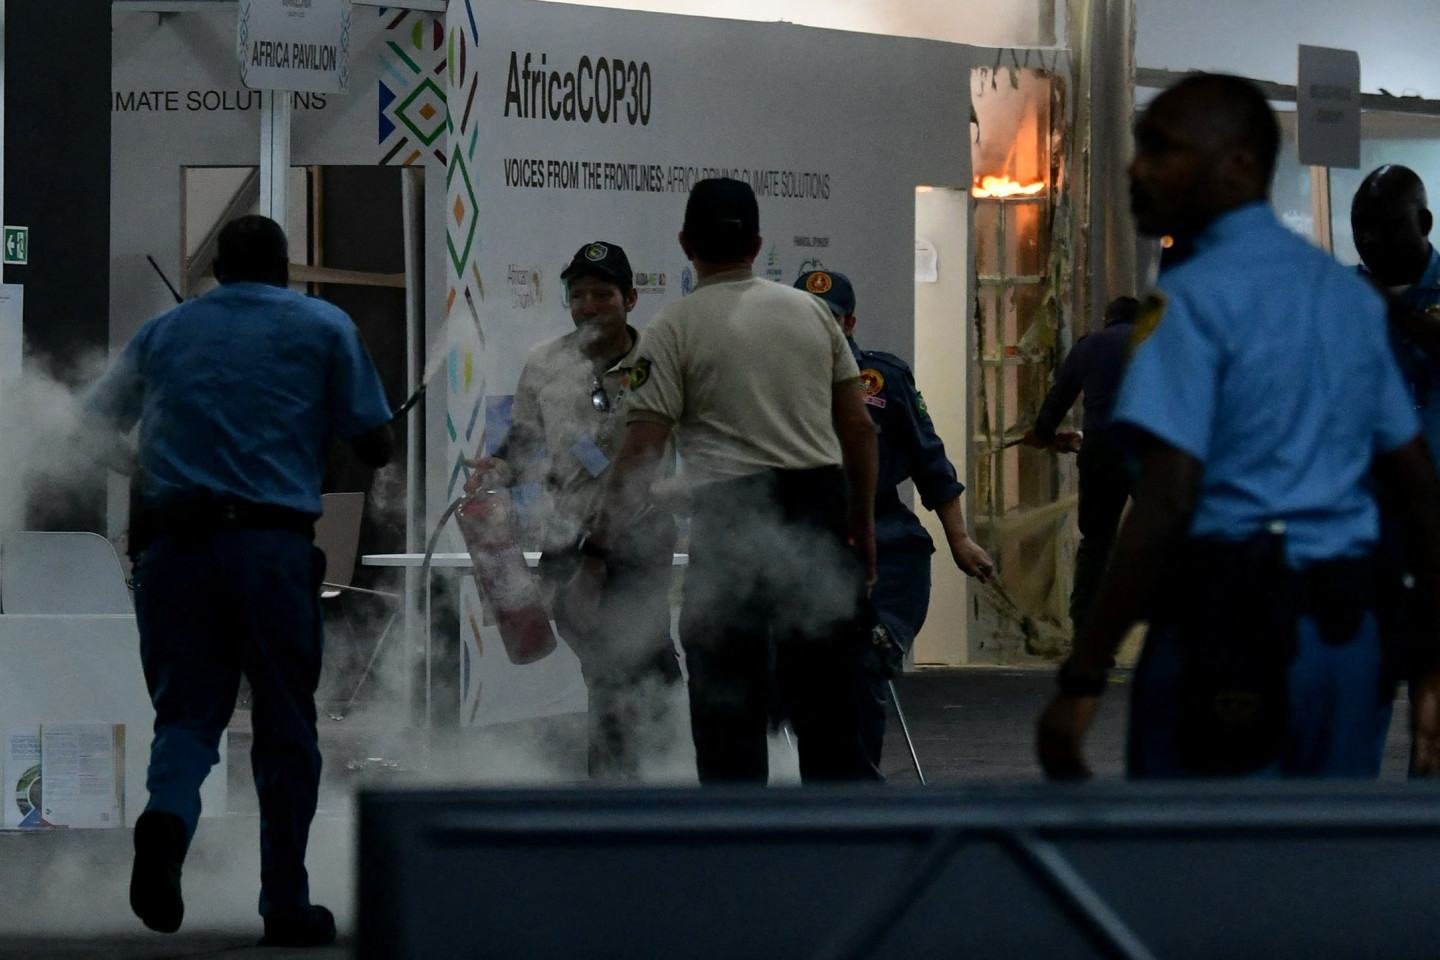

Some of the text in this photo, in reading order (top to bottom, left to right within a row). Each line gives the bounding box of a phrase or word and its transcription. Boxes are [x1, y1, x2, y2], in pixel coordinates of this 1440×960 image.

[252, 41, 337, 71] AFRICA PAVILION
[186, 90, 327, 111] SOLUTNS
[503, 50, 652, 126] AfricaCOP30
[504, 158, 545, 189] VOICES
[547, 160, 578, 189] FROM
[582, 162, 602, 191] THE
[781, 171, 831, 200] SOLUTIONS
